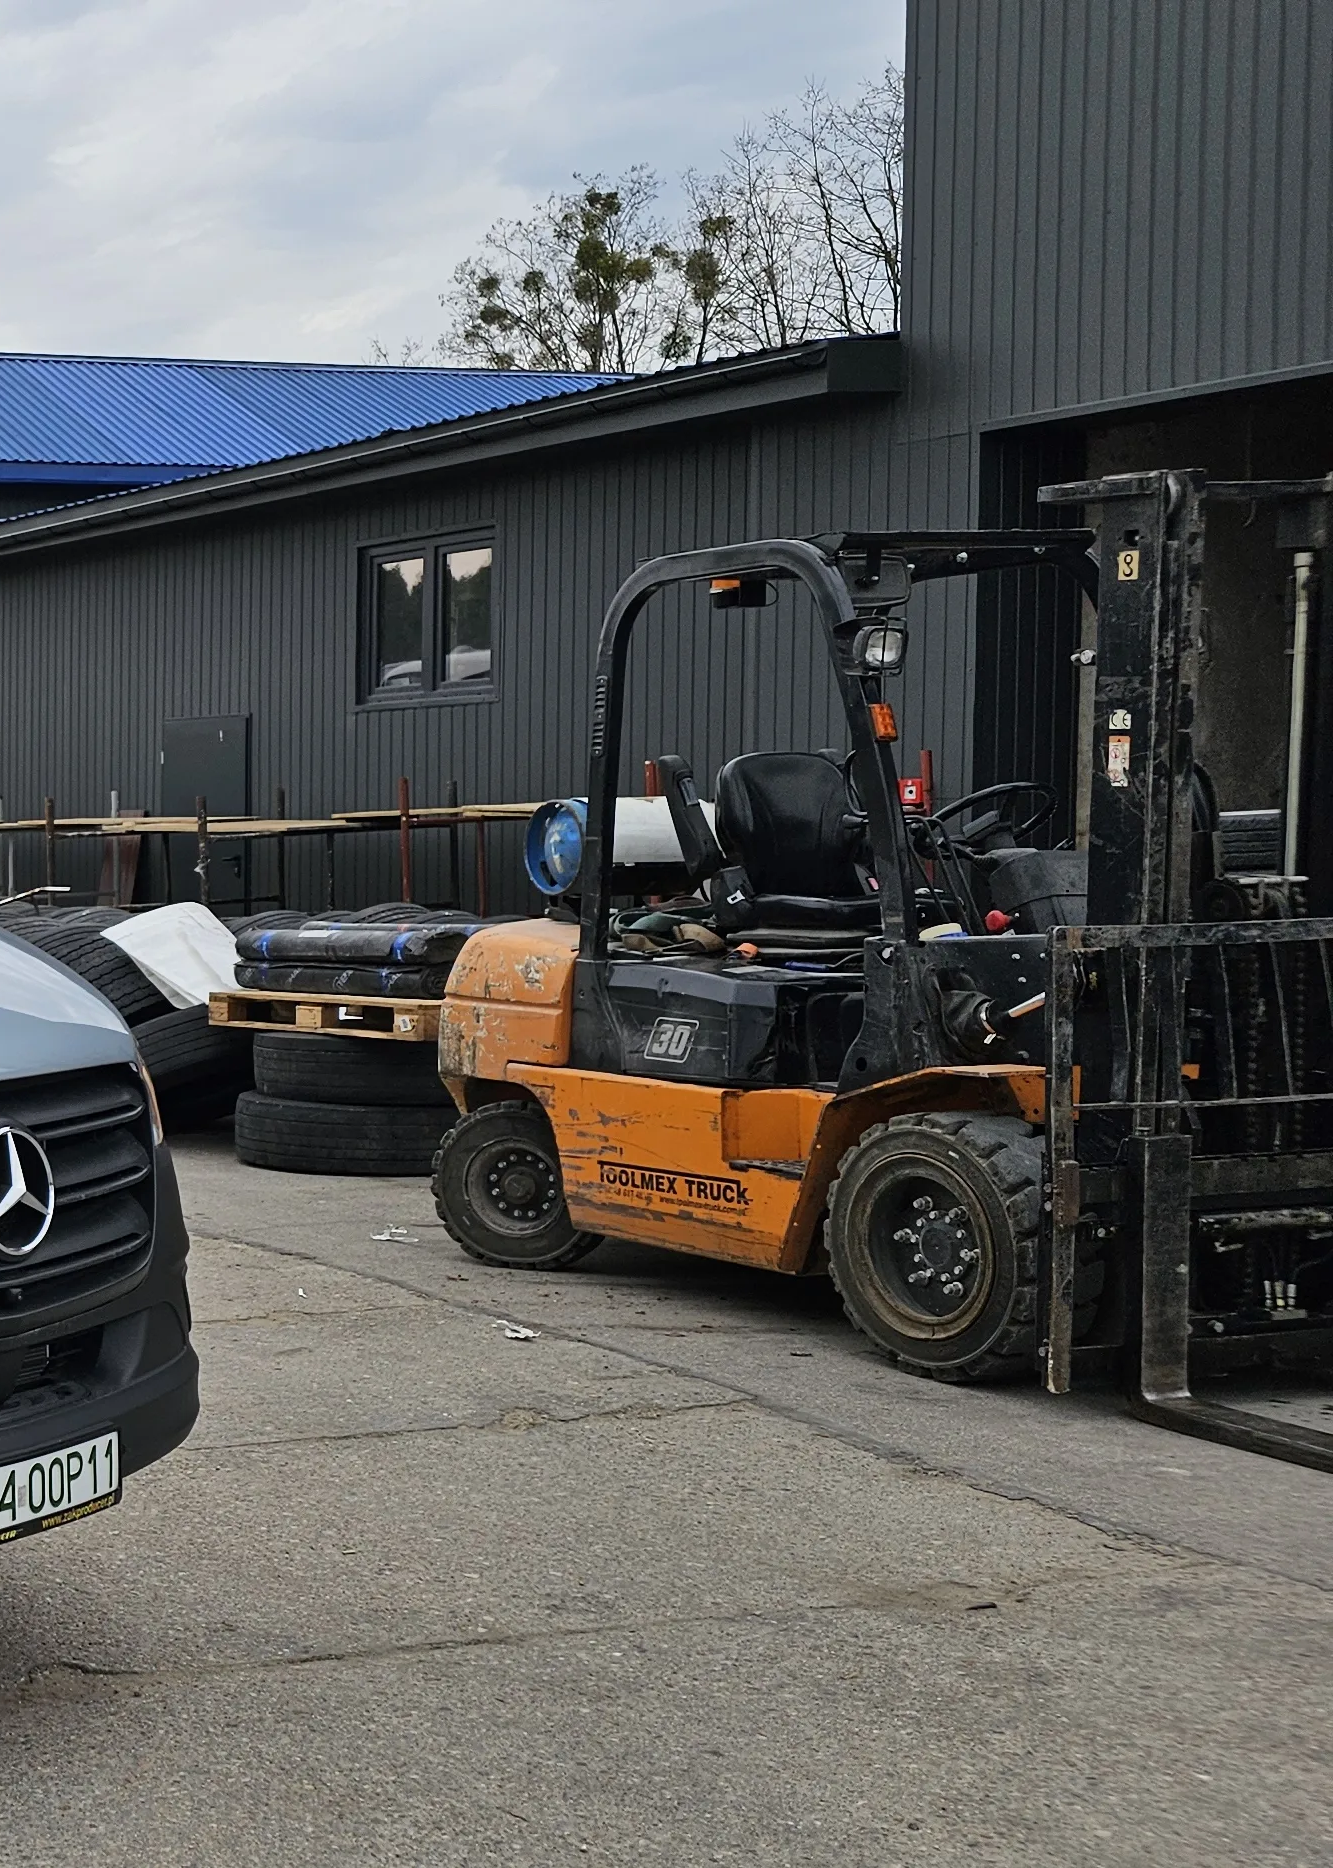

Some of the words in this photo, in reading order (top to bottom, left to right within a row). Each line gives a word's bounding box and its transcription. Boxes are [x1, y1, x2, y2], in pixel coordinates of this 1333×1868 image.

[1111, 711, 1129, 728] CE
[652, 1023, 692, 1056] 30
[597, 1160, 678, 1195] TOOLMEX
[42, 1492, 115, 1529] www.zakproducer.pl
